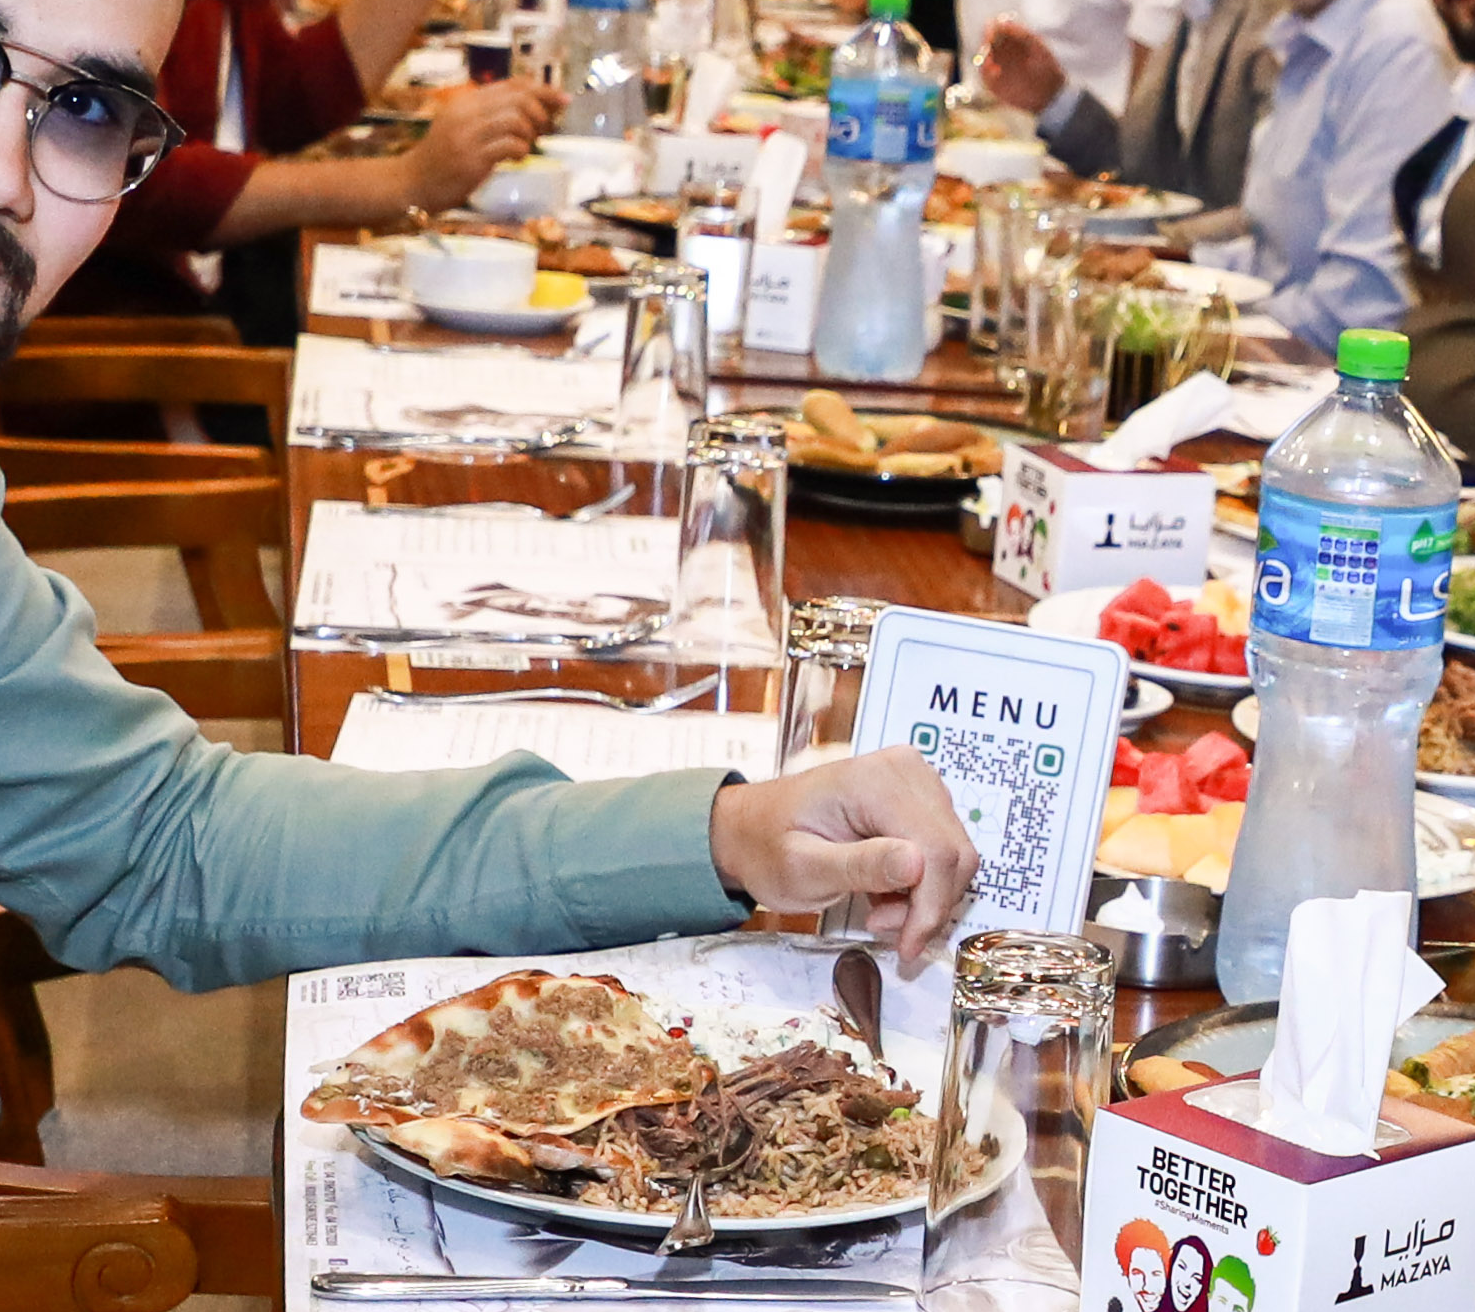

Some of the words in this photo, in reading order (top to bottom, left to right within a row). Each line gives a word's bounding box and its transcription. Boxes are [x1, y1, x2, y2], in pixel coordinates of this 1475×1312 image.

[930, 684, 1057, 729] MENU
[1152, 1146, 1236, 1198] BETTER
[1137, 1165, 1248, 1229] TOGETHER
[1155, 1199, 1229, 1235] #SharingMoments
[1384, 1218, 1455, 1260] مزايا
[1381, 1255, 1451, 1291] MAZAYA
